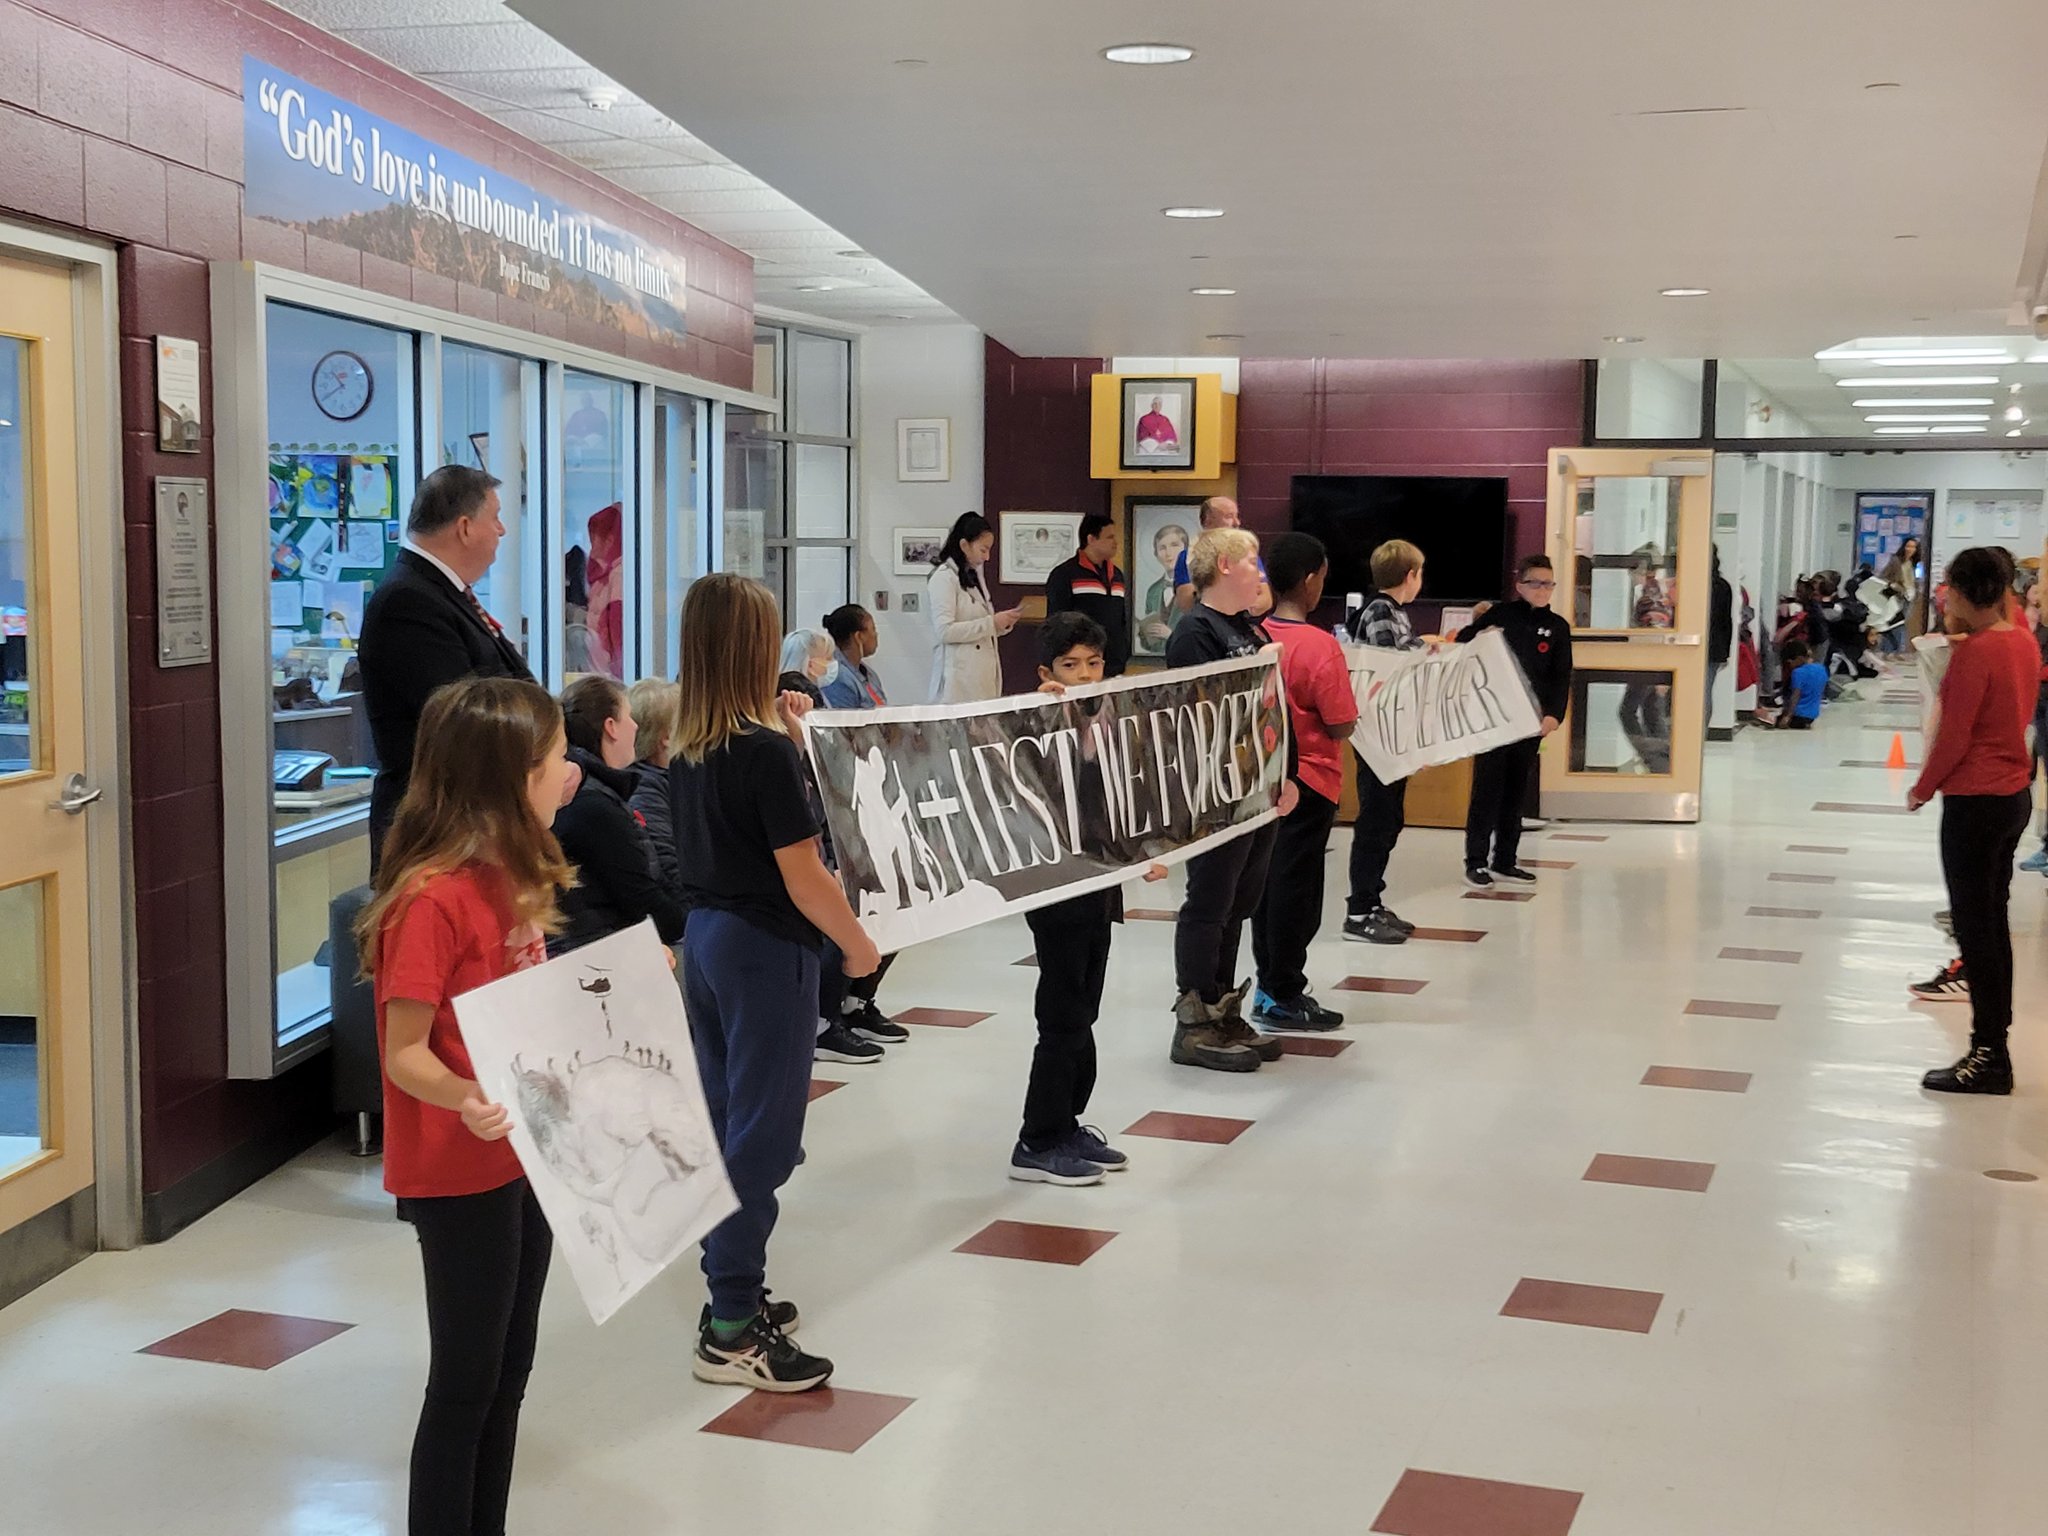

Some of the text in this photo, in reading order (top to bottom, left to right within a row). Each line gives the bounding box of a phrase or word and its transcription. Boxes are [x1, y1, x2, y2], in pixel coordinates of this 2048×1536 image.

[371, 127, 423, 208] love
[428, 152, 448, 216] is
[451, 175, 564, 262] unbounded.
[568, 216, 582, 268] It
[586, 224, 612, 280] has
[615, 250, 632, 287] no
[500, 253, 550, 292] Pope Francis
[950, 728, 1082, 877] LEST
[1091, 715, 1151, 843] WE
[1150, 687, 1264, 828] FORGET
